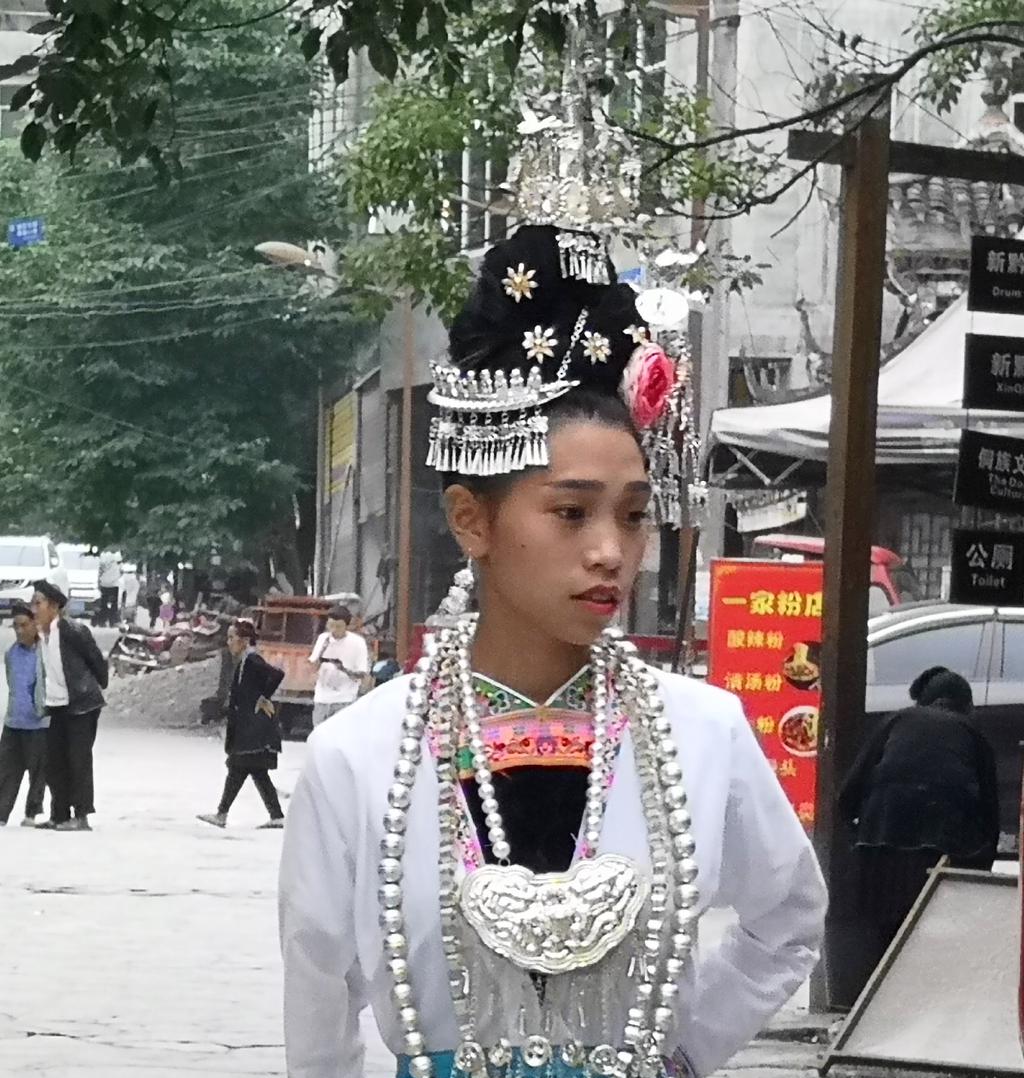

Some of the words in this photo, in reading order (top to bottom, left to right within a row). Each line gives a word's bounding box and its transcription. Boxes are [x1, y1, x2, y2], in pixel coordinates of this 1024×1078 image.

[971, 573, 1005, 588] Toilet
[727, 629, 784, 650] 酸辣粉
